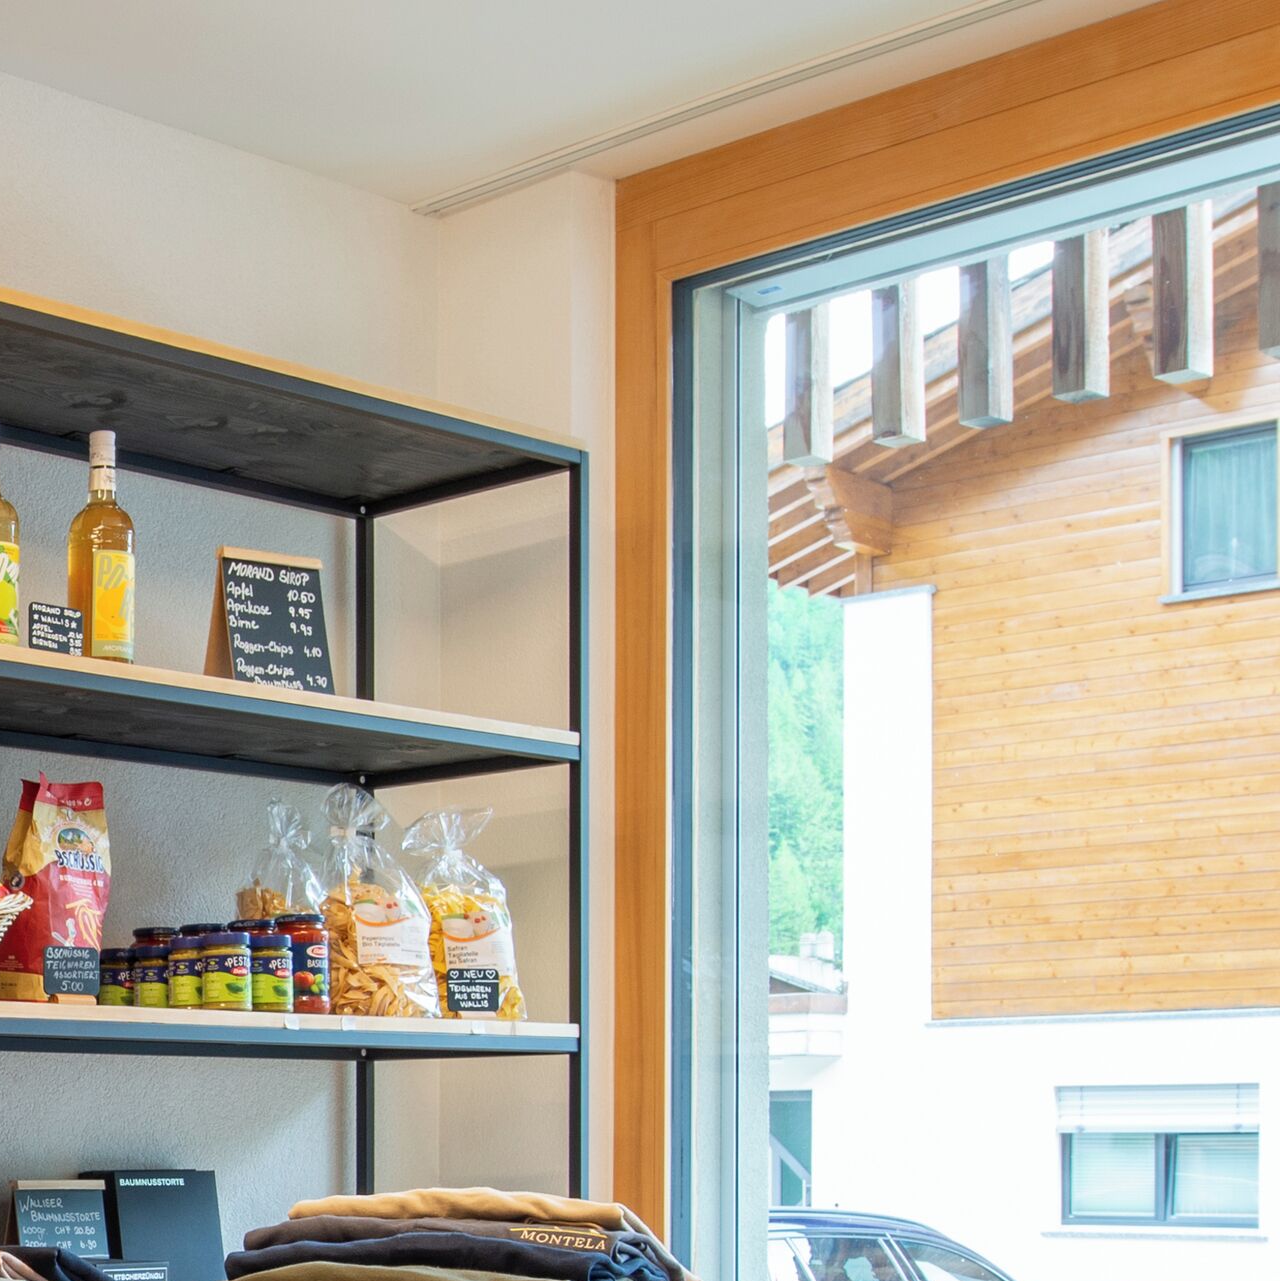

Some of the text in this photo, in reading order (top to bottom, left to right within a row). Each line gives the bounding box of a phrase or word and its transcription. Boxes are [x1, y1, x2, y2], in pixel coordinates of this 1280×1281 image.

[228, 562, 310, 586] MORAND SIROP
[226, 581, 253, 600] Apfel
[226, 598, 313, 620] Aprikose 9.95
[40, 614, 70, 628] WALLIS
[228, 615, 313, 636] Birne 9.95
[46, 946, 91, 958] BSCHÜSSIG
[53, 970, 100, 981] ASSORTIERT
[463, 970, 484, 979] NEU
[449, 984, 491, 993] TEIGWAREN
[460, 1000, 489, 1008] WALLIS
[119, 1178, 185, 1187] BAUMNUSSTORTE
[30, 1210, 101, 1222] BAUMNUSSTORTE
[520, 1230, 607, 1250] MONTELA
